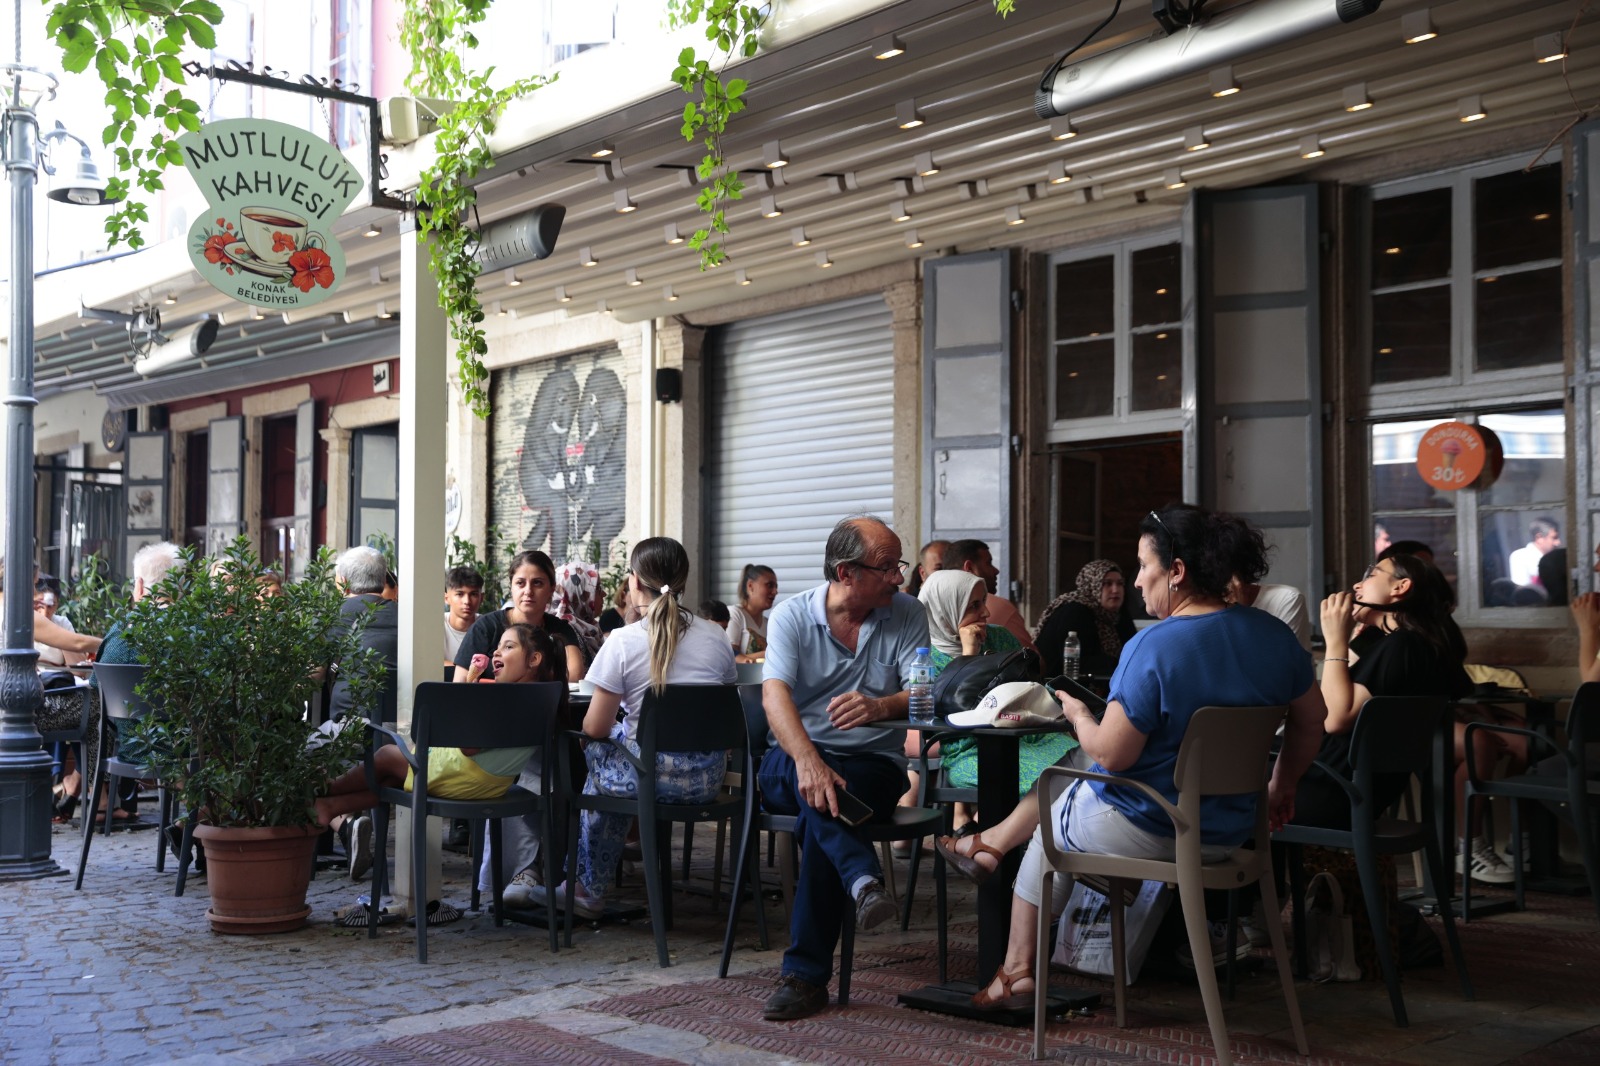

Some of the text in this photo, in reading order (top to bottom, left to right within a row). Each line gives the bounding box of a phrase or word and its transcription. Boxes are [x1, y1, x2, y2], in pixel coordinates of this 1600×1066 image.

[185, 131, 358, 199] MUTLULUK
[211, 170, 335, 220] KAHVESİ
[237, 287, 299, 304] BELEDİYESİ
[251, 281, 286, 294] KONAK
